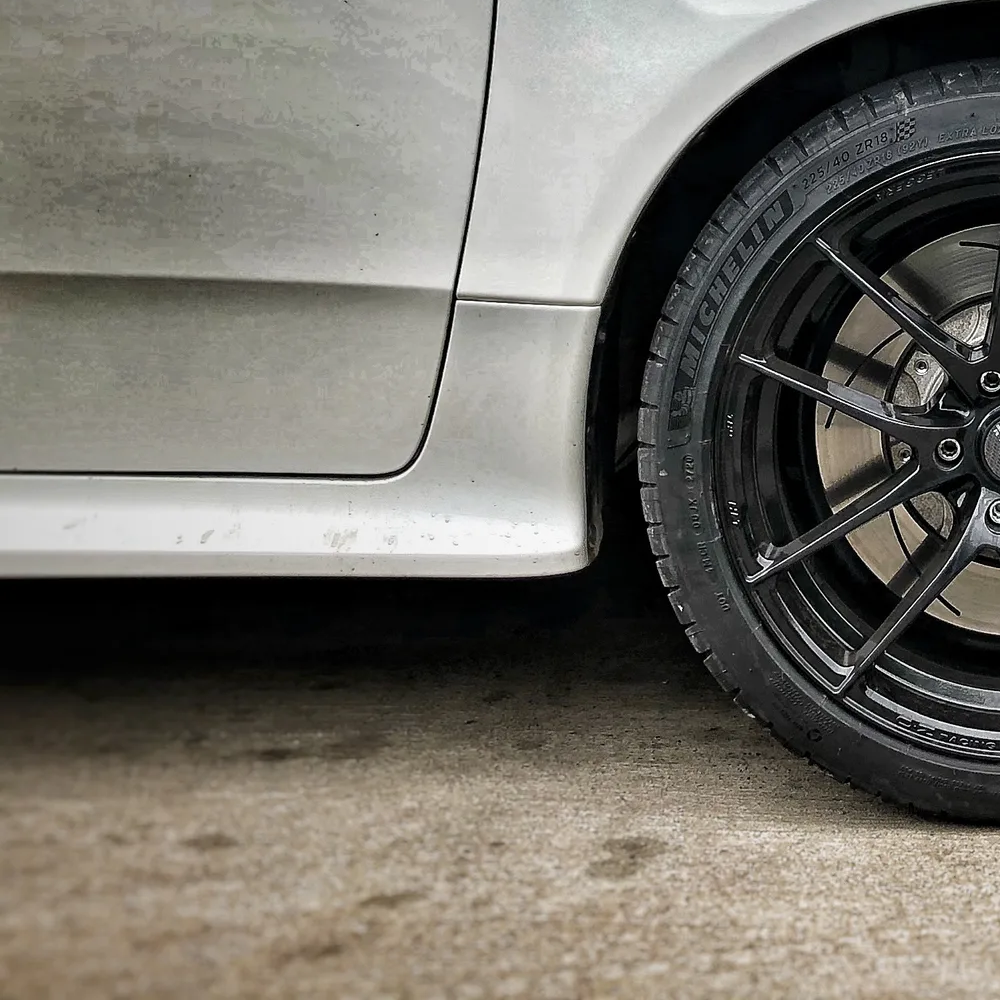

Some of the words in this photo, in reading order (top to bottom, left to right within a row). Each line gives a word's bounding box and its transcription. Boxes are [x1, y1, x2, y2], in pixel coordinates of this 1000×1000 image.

[802, 151, 850, 190] 225/40
[855, 131, 889, 156] ZR18
[938, 127, 977, 143] EXTRA
[680, 199, 786, 379] MICHELIN
